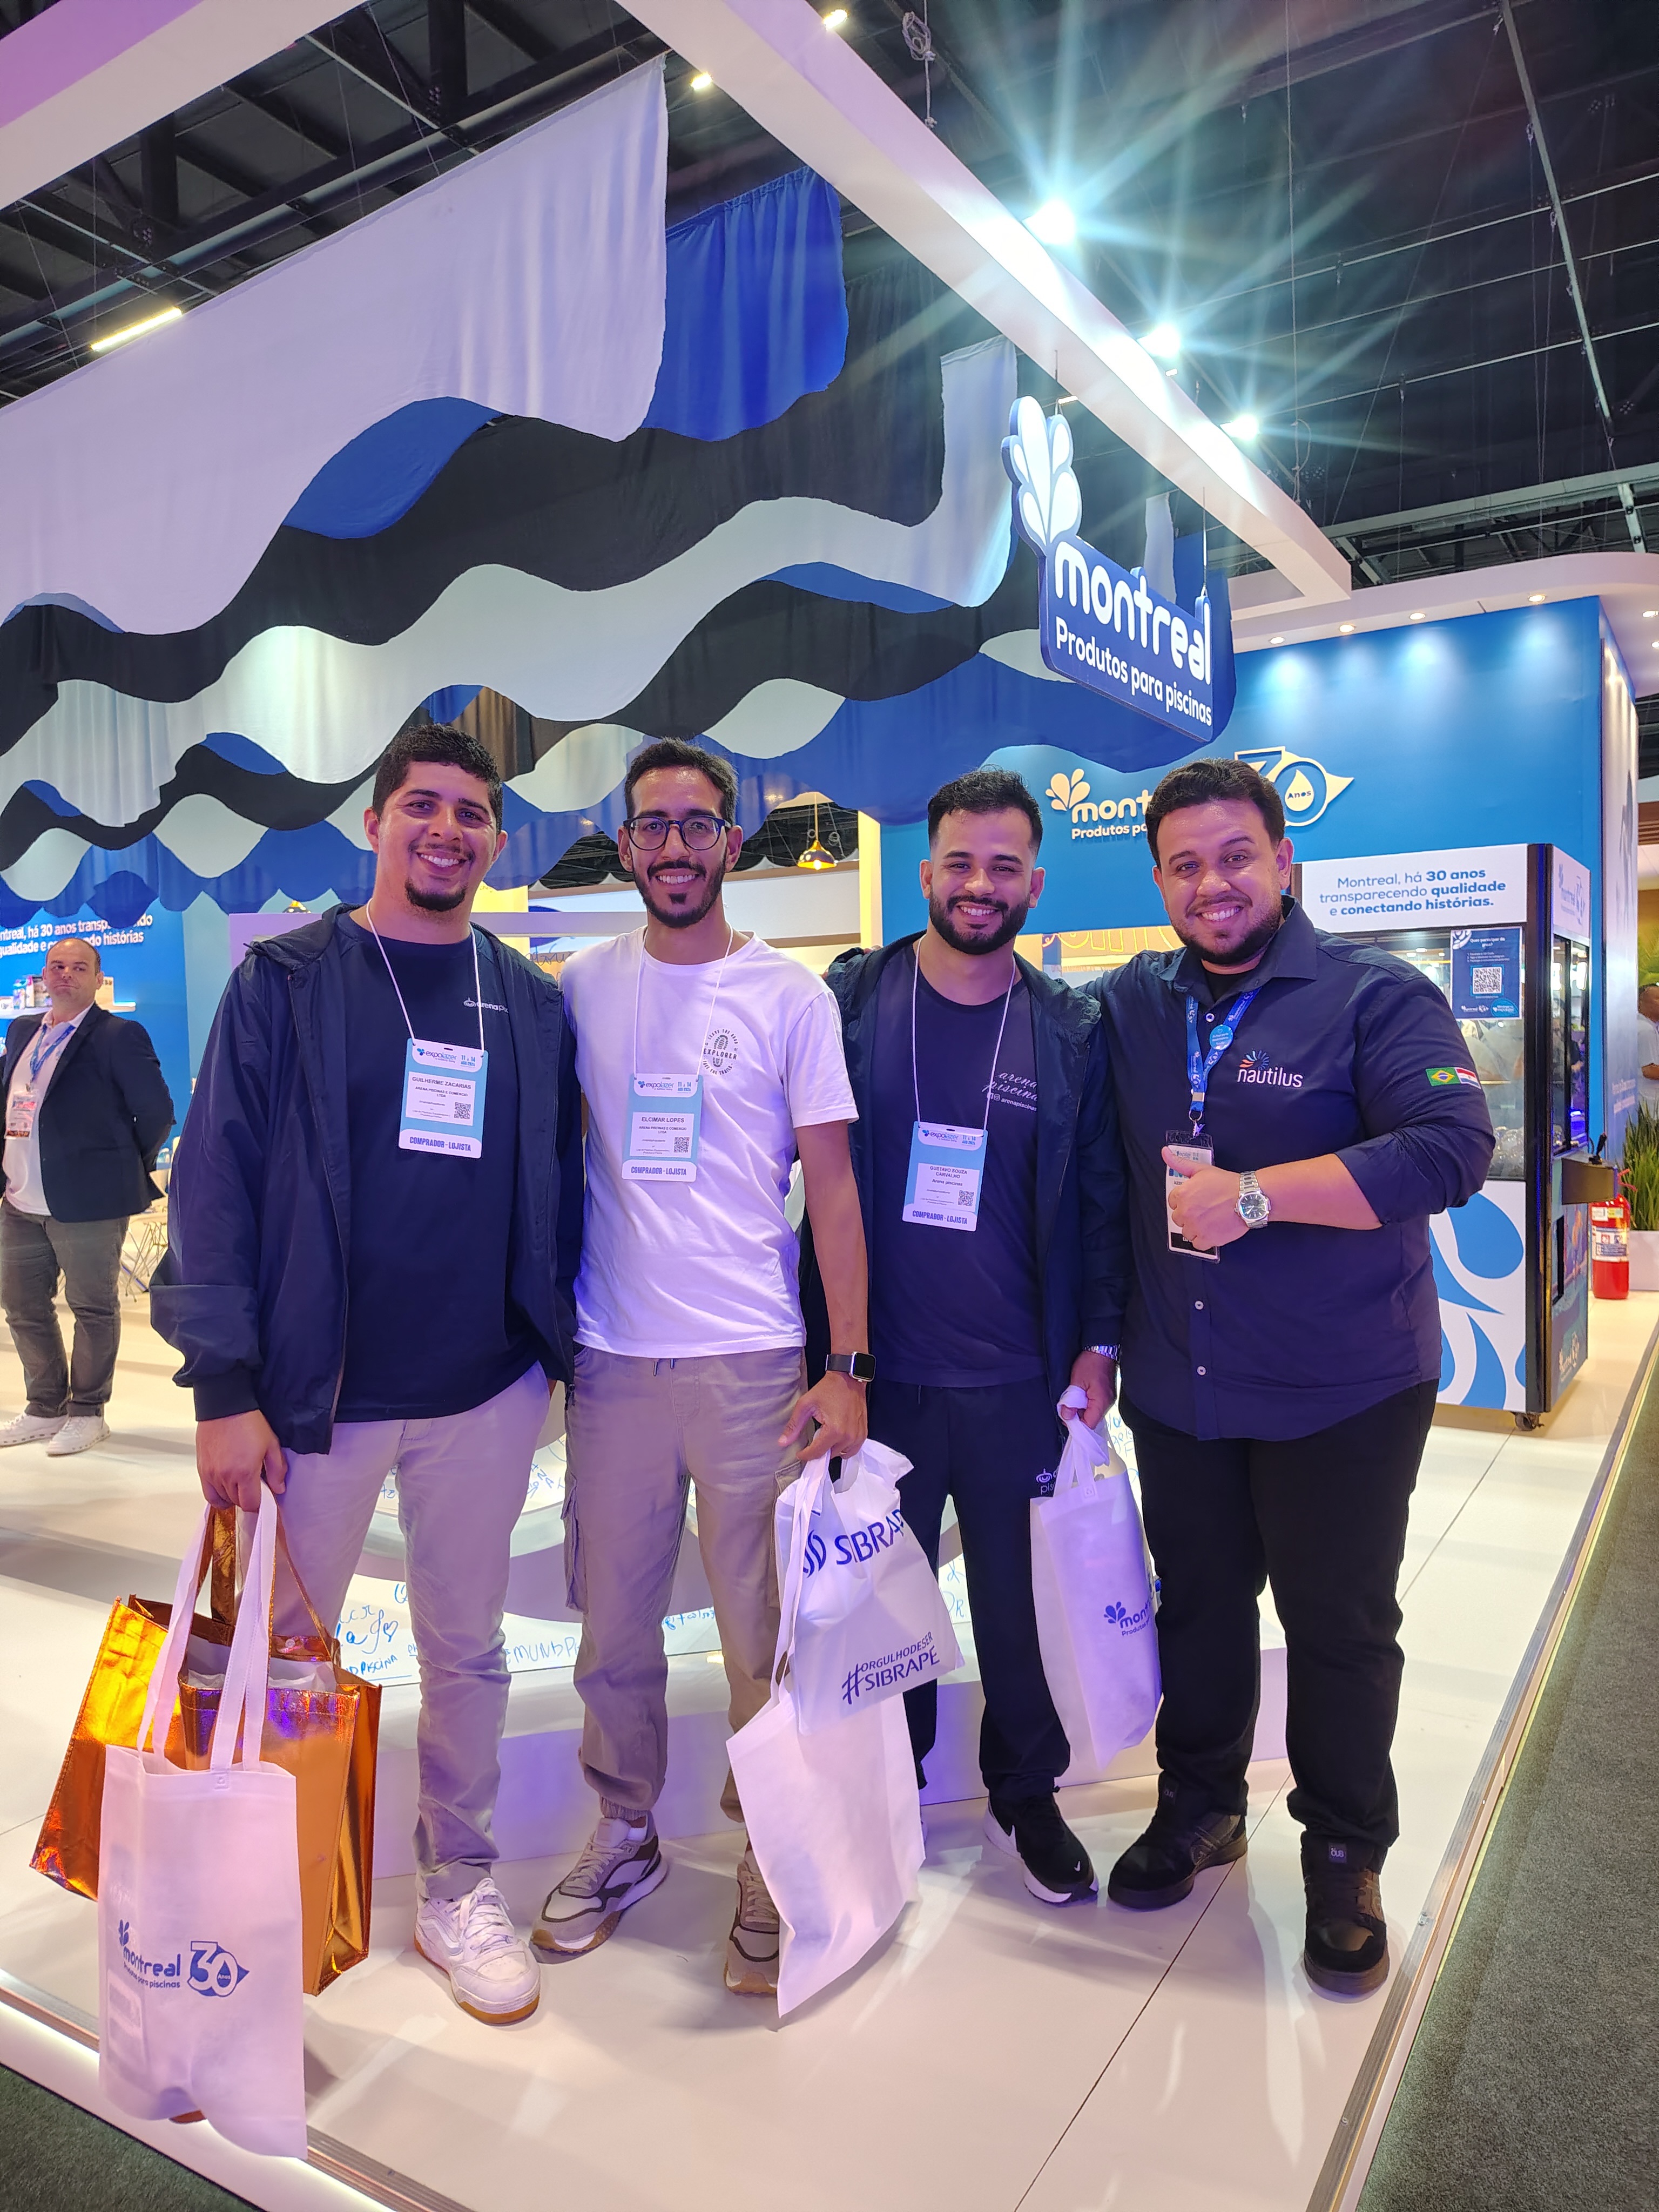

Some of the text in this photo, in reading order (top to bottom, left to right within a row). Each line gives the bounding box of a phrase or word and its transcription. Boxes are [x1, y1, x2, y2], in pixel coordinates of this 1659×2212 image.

[1055, 541, 1211, 685] montreal
[1055, 616, 1212, 727] Produtos para piscinas
[1287, 790, 1312, 799] Anos
[1072, 825, 1130, 839] Produtos
[1337, 869, 1486, 888] Montreal, há 30 anos
[1319, 881, 1506, 903] transparecendo qualidade
[1330, 898, 1494, 916] e conectando histórias.
[28, 925, 39, 939] há
[41, 923, 53, 937] 30
[55, 923, 77, 935] anos
[103, 930, 144, 946] histórias
[41, 942, 46, 952] e
[426, 1051, 457, 1060] expolazer
[703, 1048, 737, 1060] EXPLORER
[412, 1077, 471, 1089] GUILHERME ZACARIAS
[999, 1073, 1037, 1089] arena
[1237, 1067, 1304, 1088] nautilus
[1001, 1097, 1037, 1111] arenapiscinas
[409, 1136, 444, 1148] COMPRADOR
[448, 1142, 471, 1151] LOJISTA
[631, 1166, 662, 1175] COMPRADOR
[666, 1168, 687, 1176] LOJISTA
[912, 1210, 943, 1221] COMPRADOR
[947, 1215, 967, 1225] LOJISTA
[123, 1946, 181, 1977] montreal
[187, 1941, 238, 1998] 30
[150, 1980, 180, 1988] piscinas
